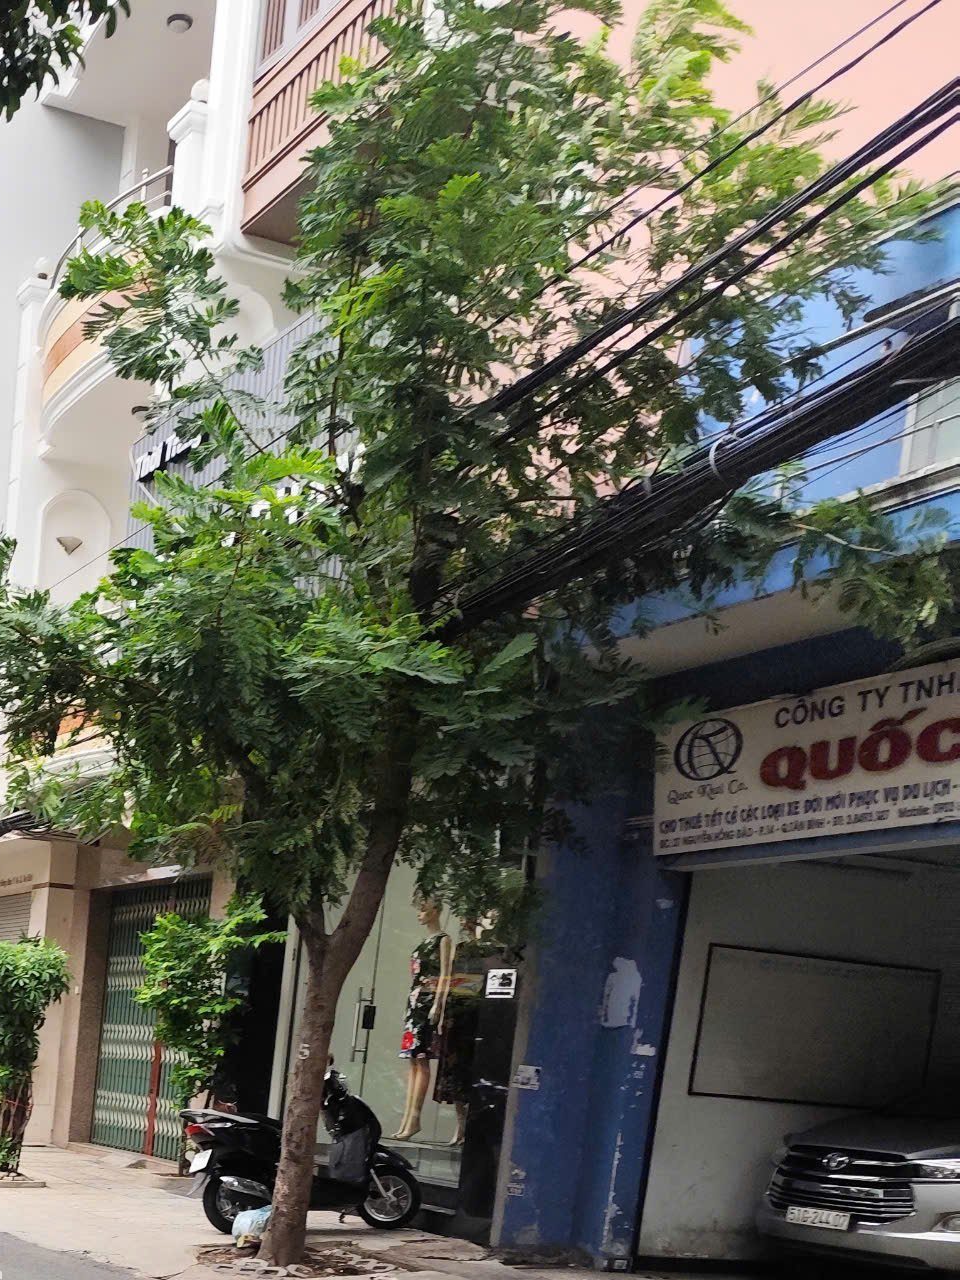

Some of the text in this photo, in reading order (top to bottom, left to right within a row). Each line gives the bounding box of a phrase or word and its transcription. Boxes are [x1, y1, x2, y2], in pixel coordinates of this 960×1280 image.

[775, 671, 960, 728] CÔNG TY TNH
[760, 707, 960, 790] QUỐC
